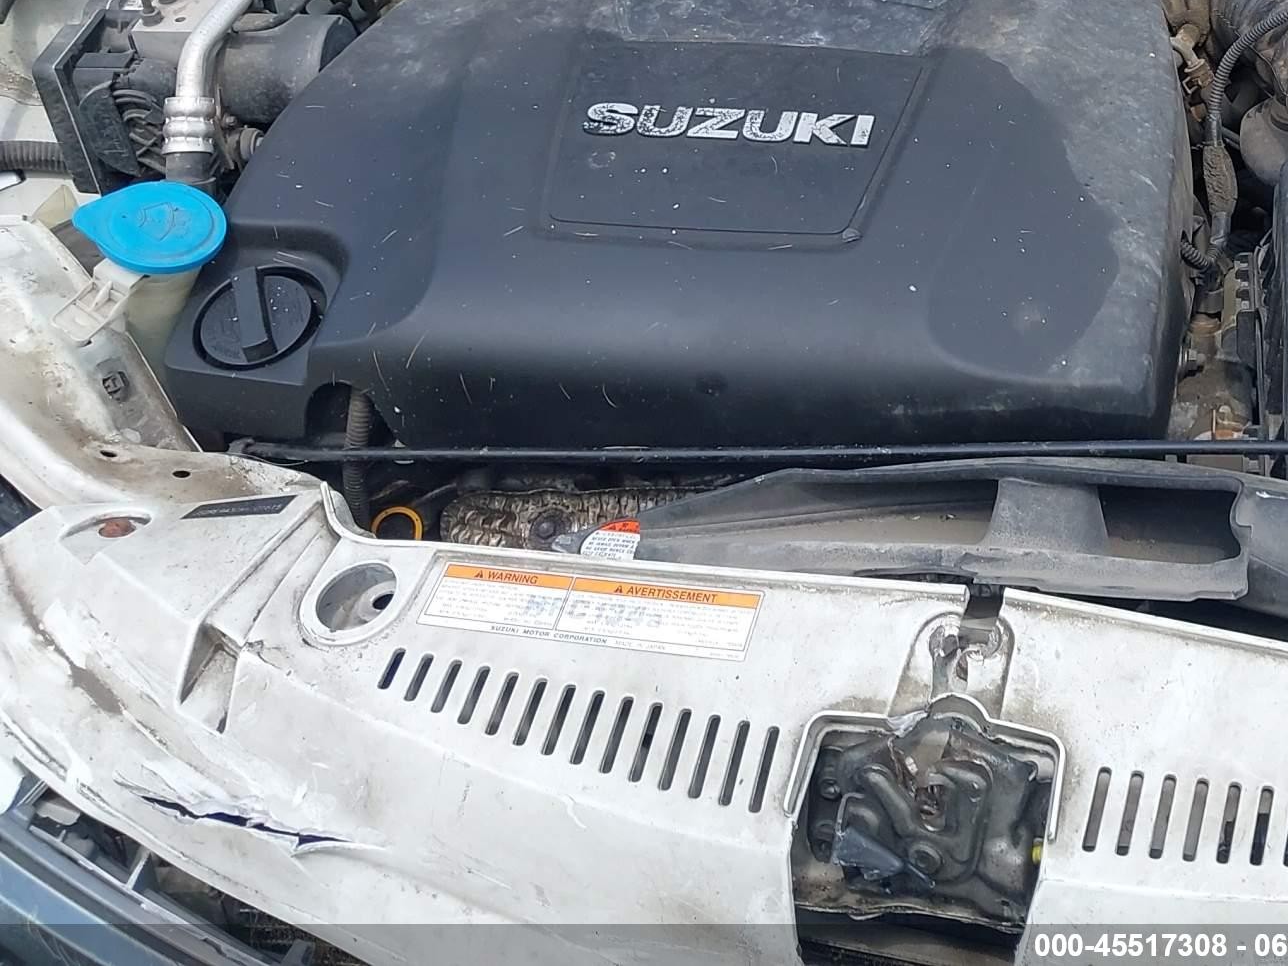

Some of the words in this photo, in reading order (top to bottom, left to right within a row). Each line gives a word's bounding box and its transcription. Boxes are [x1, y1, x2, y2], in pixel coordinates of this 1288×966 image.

[582, 101, 875, 146] SUZUKI
[488, 569, 539, 585] WARNING
[626, 586, 719, 604] AVERTISSEMENT
[491, 625, 520, 634] SUZUKI
[523, 628, 550, 637] MOTOR
[554, 632, 608, 645] CORPORATION
